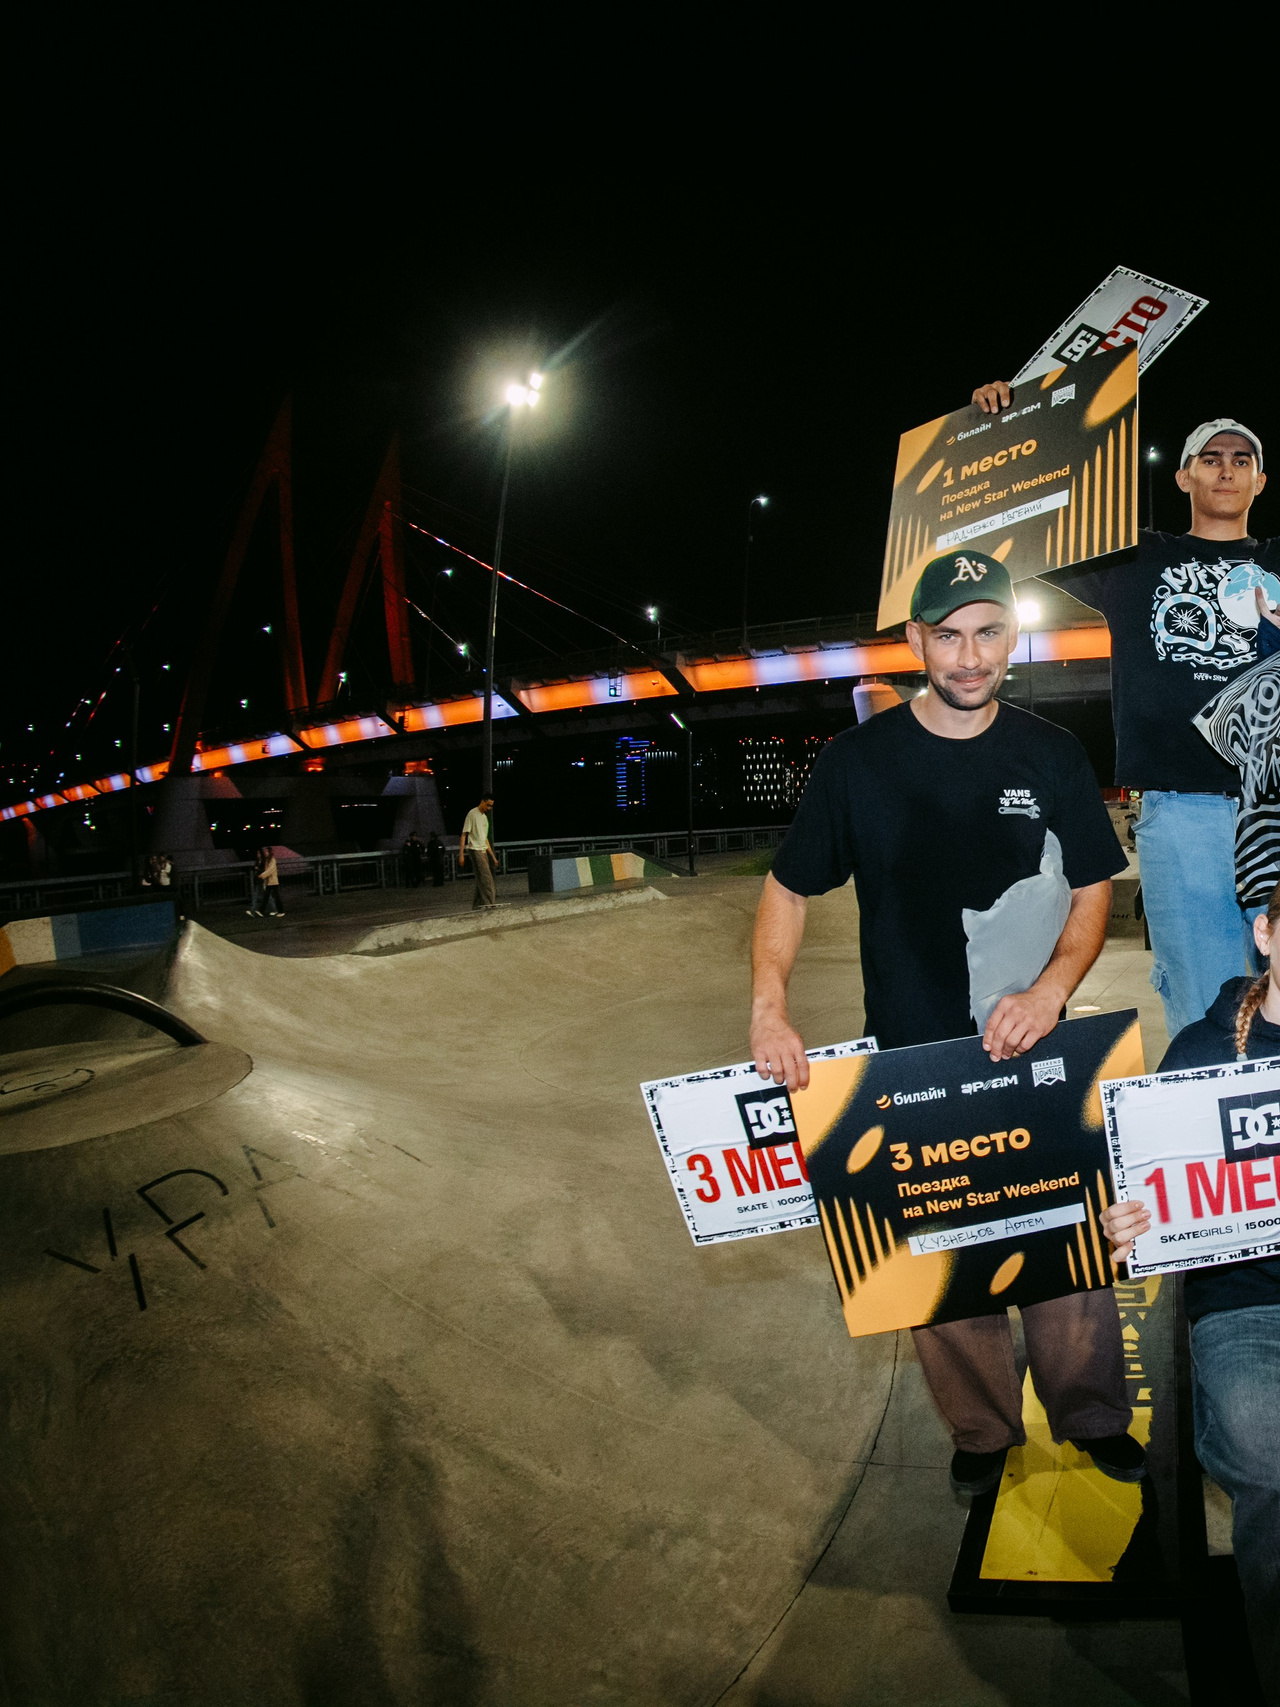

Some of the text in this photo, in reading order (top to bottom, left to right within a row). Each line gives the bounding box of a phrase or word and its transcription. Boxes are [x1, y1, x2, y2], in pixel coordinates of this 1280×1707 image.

[1060, 329, 1100, 363] DC
[957, 422, 992, 441] билайн
[942, 439, 1038, 488] 1 место
[939, 464, 1070, 521] на New Star Weekend
[941, 480, 991, 506] Поездка
[949, 556, 988, 586] A's
[1003, 789, 1031, 798] VANS
[893, 1087, 947, 1106] билайн
[744, 1096, 796, 1139] DC
[889, 1127, 1031, 1172] 3 место
[686, 1153, 722, 1204] 3
[897, 1175, 971, 1198] Поездка
[737, 1202, 769, 1214] SKATE
[902, 1171, 1080, 1219] на New Star Weekend
[1144, 1167, 1173, 1225] 1
[916, 1226, 995, 1252] КУЗНЕЦОВ
[1160, 1225, 1233, 1244] SKATEGIRLS
